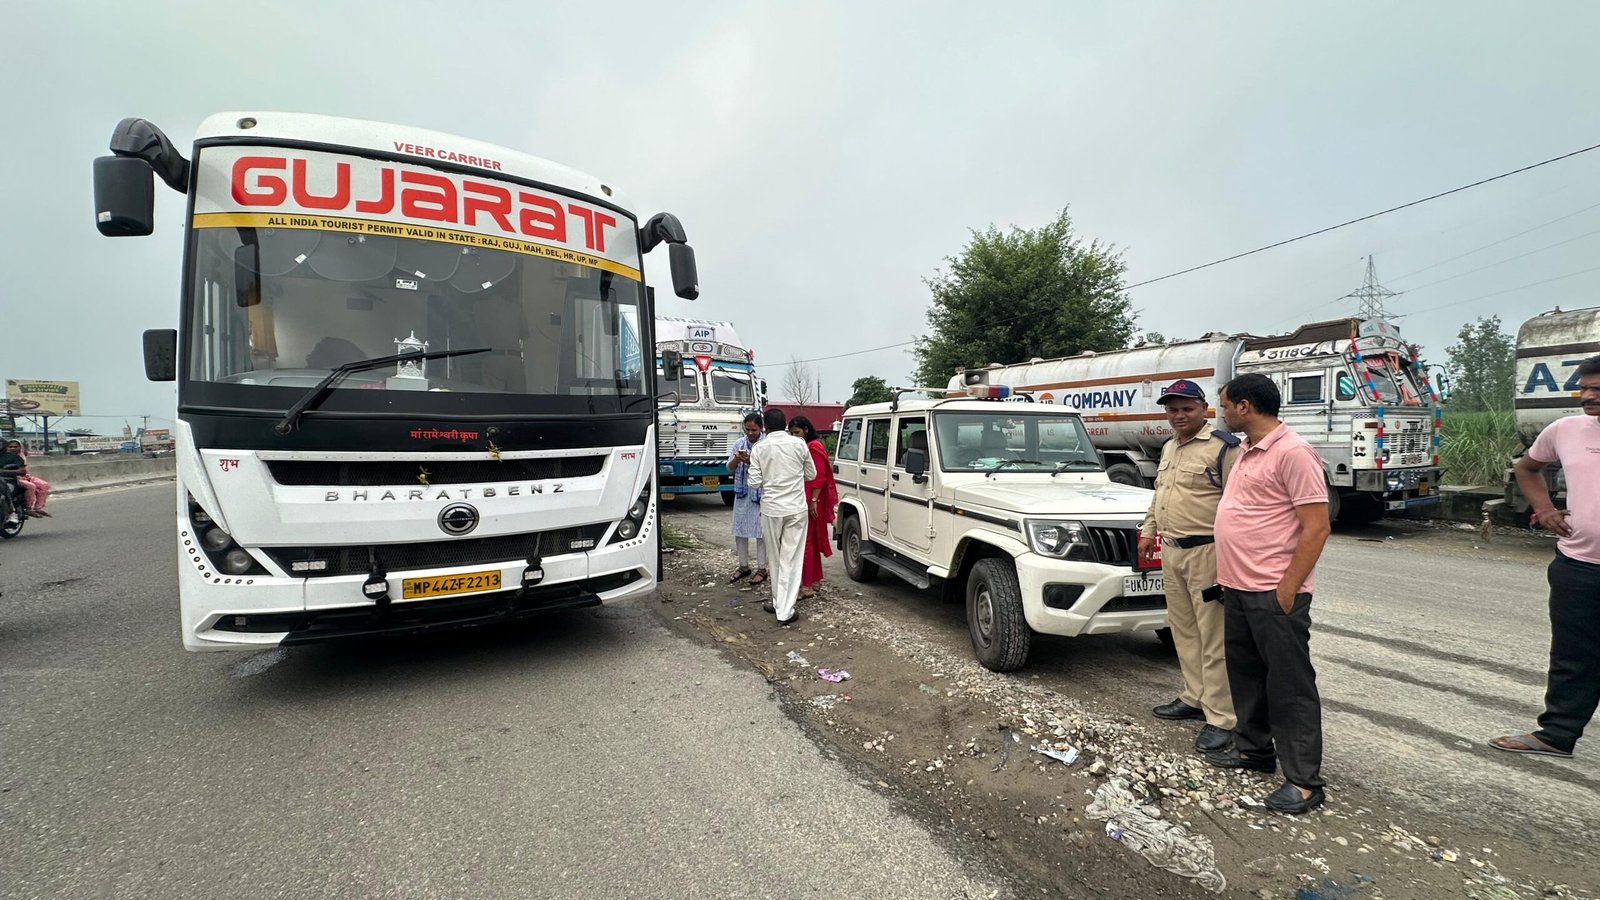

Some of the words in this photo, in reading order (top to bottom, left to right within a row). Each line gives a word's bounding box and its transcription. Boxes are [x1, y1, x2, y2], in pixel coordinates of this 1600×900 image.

[393, 141, 435, 158] VEER
[437, 149, 502, 171] CARRIER
[268, 217, 287, 225] ALL
[290, 218, 318, 227] INDIA
[321, 220, 364, 231] TOURIST
[367, 224, 403, 235] PERMIT
[406, 228, 434, 238] VALID
[436, 231, 446, 240] IN
[503, 240, 522, 251] GUJ,
[524, 244, 543, 255] MAH,
[545, 248, 562, 259] DEL,
[588, 258, 599, 266] MP
[694, 330, 710, 338] AIP
[1523, 360, 1584, 393] AZ
[1063, 388, 1137, 409] COMPANY
[1156, 425, 1174, 435] Smo
[219, 459, 240, 472] शुभ
[325, 483, 564, 502] BHARATBENZ
[1130, 579, 1164, 593] UK07G
